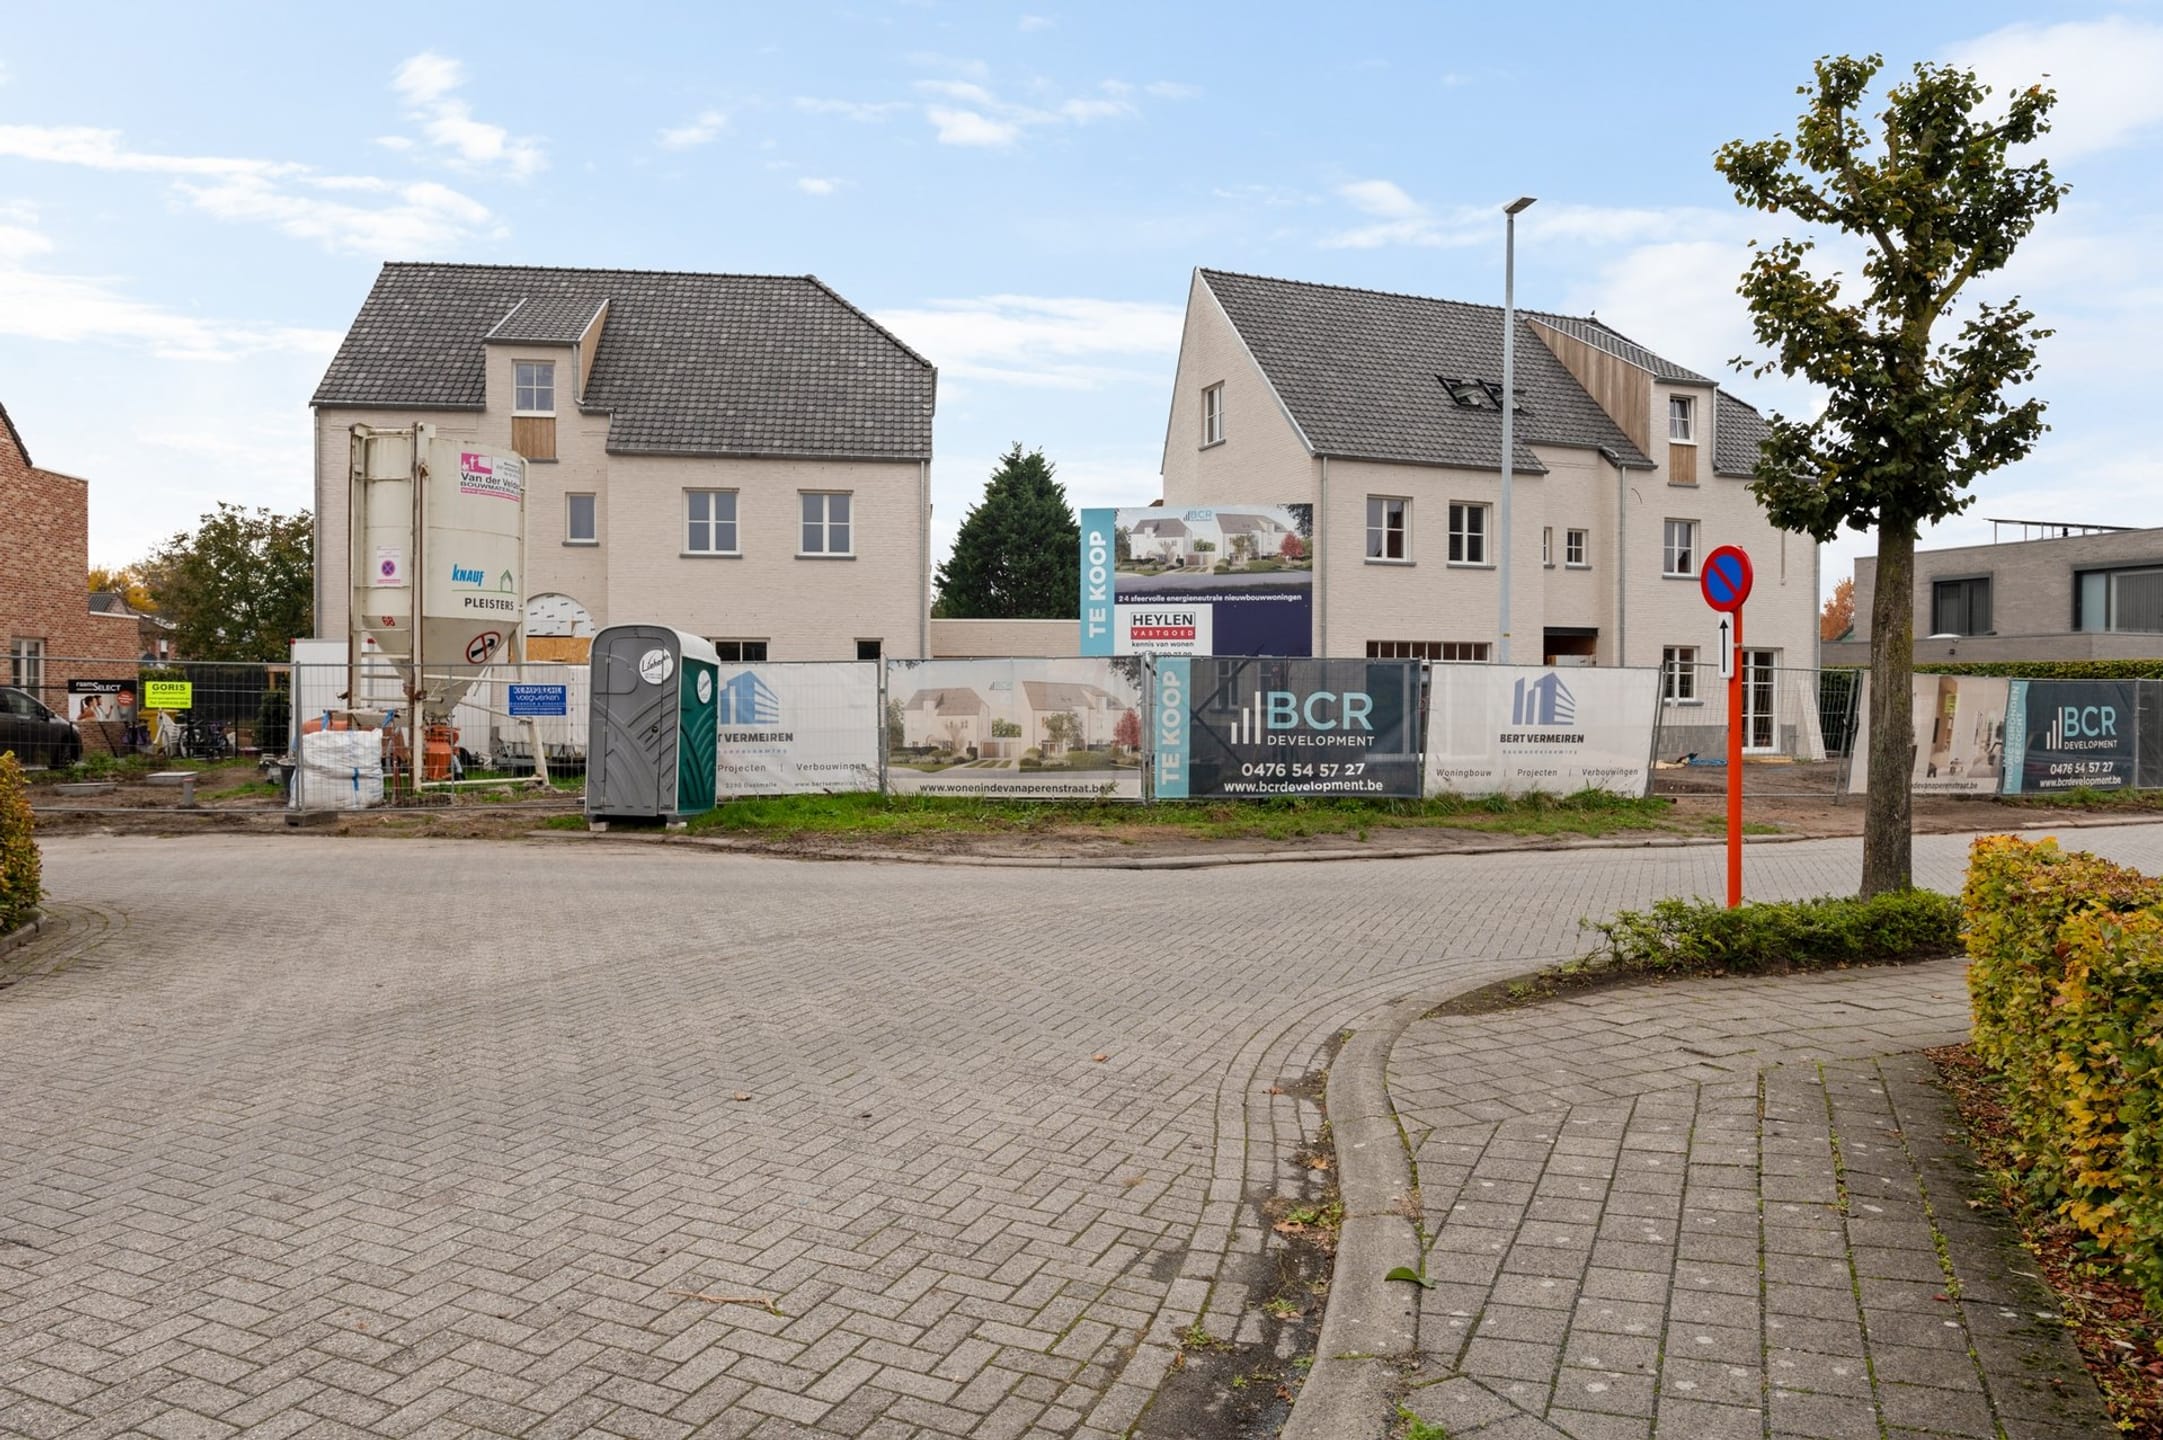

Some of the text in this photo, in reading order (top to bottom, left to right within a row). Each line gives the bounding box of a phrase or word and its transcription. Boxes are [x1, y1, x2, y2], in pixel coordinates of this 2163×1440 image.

[461, 472, 482, 482] Van
[485, 476, 501, 485] der
[1089, 530, 1107, 639] TE KOOP
[464, 597, 514, 611] PLEISTERS
[1131, 594, 1166, 603] sfeervolle
[1166, 594, 1224, 604] energieneutrale
[1224, 593, 1303, 604] nieuwbouwwoningen
[1132, 614, 1194, 626] HEYLEN
[1132, 629, 1194, 637] VASTGOED
[152, 683, 186, 691] GORIS
[1267, 690, 1374, 731] BCR
[1161, 670, 1181, 785] TE KOOP
[2063, 706, 2117, 737] BCR
[724, 732, 794, 743] VERMEIREN
[1267, 735, 1375, 747] DEVELOPMENT
[1499, 734, 1585, 744] BERT VERMEIREN
[2063, 739, 2118, 750] DEVELOPMENT
[718, 763, 766, 775] Projecten
[1241, 762, 1366, 778] 0476 54 57 27
[1436, 767, 1639, 778] Woningbouw Projecten Verbouwingen
[2049, 761, 2115, 776] 0476 54 57 27
[1223, 779, 1384, 793] www.bcrdevelopment.be
[2039, 775, 2122, 788] www.bcrdevelopment.be
[919, 781, 1106, 796] www.wonenindevanaperenstraat.be
